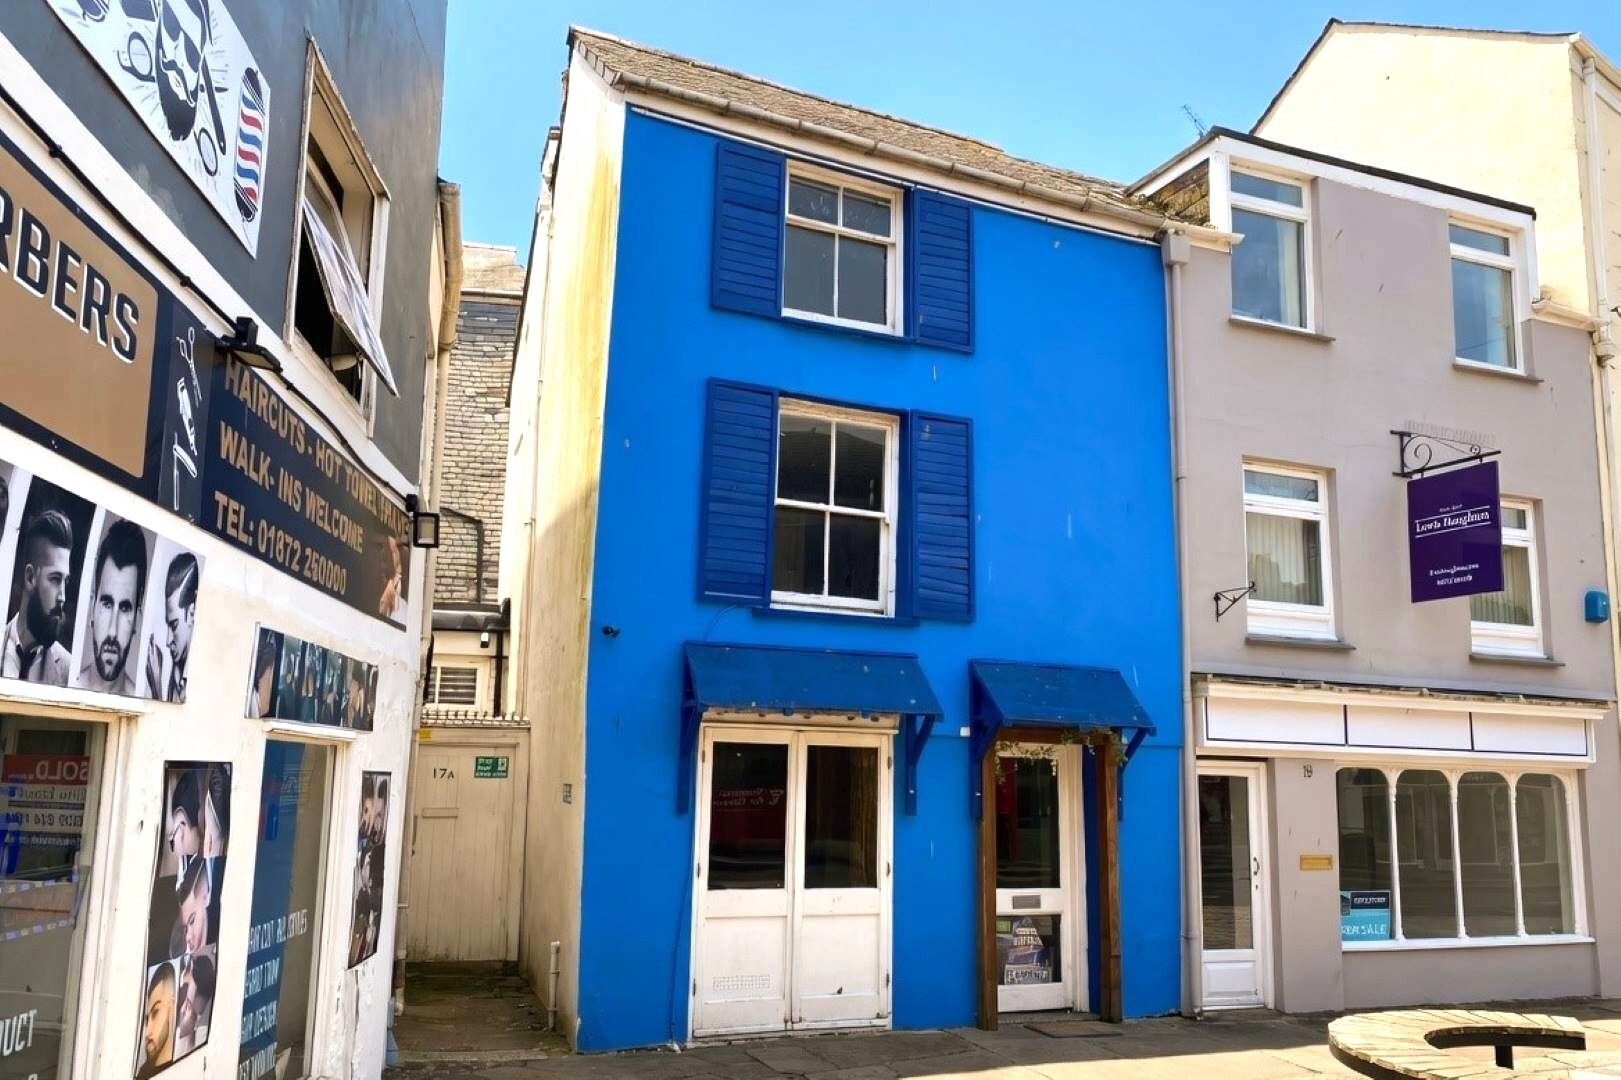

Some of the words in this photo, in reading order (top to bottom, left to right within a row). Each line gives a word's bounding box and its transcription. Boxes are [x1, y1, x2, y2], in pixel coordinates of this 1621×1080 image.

[224, 351, 306, 454] HAIRCUTS
[315, 438, 343, 482] HOT
[214, 490, 254, 547] TEL:
[257, 518, 301, 574] 01872
[278, 467, 302, 513] INS
[305, 487, 364, 554] WELCOME
[433, 767, 455, 780] 17A
[1360, 923, 1388, 936] SALE
